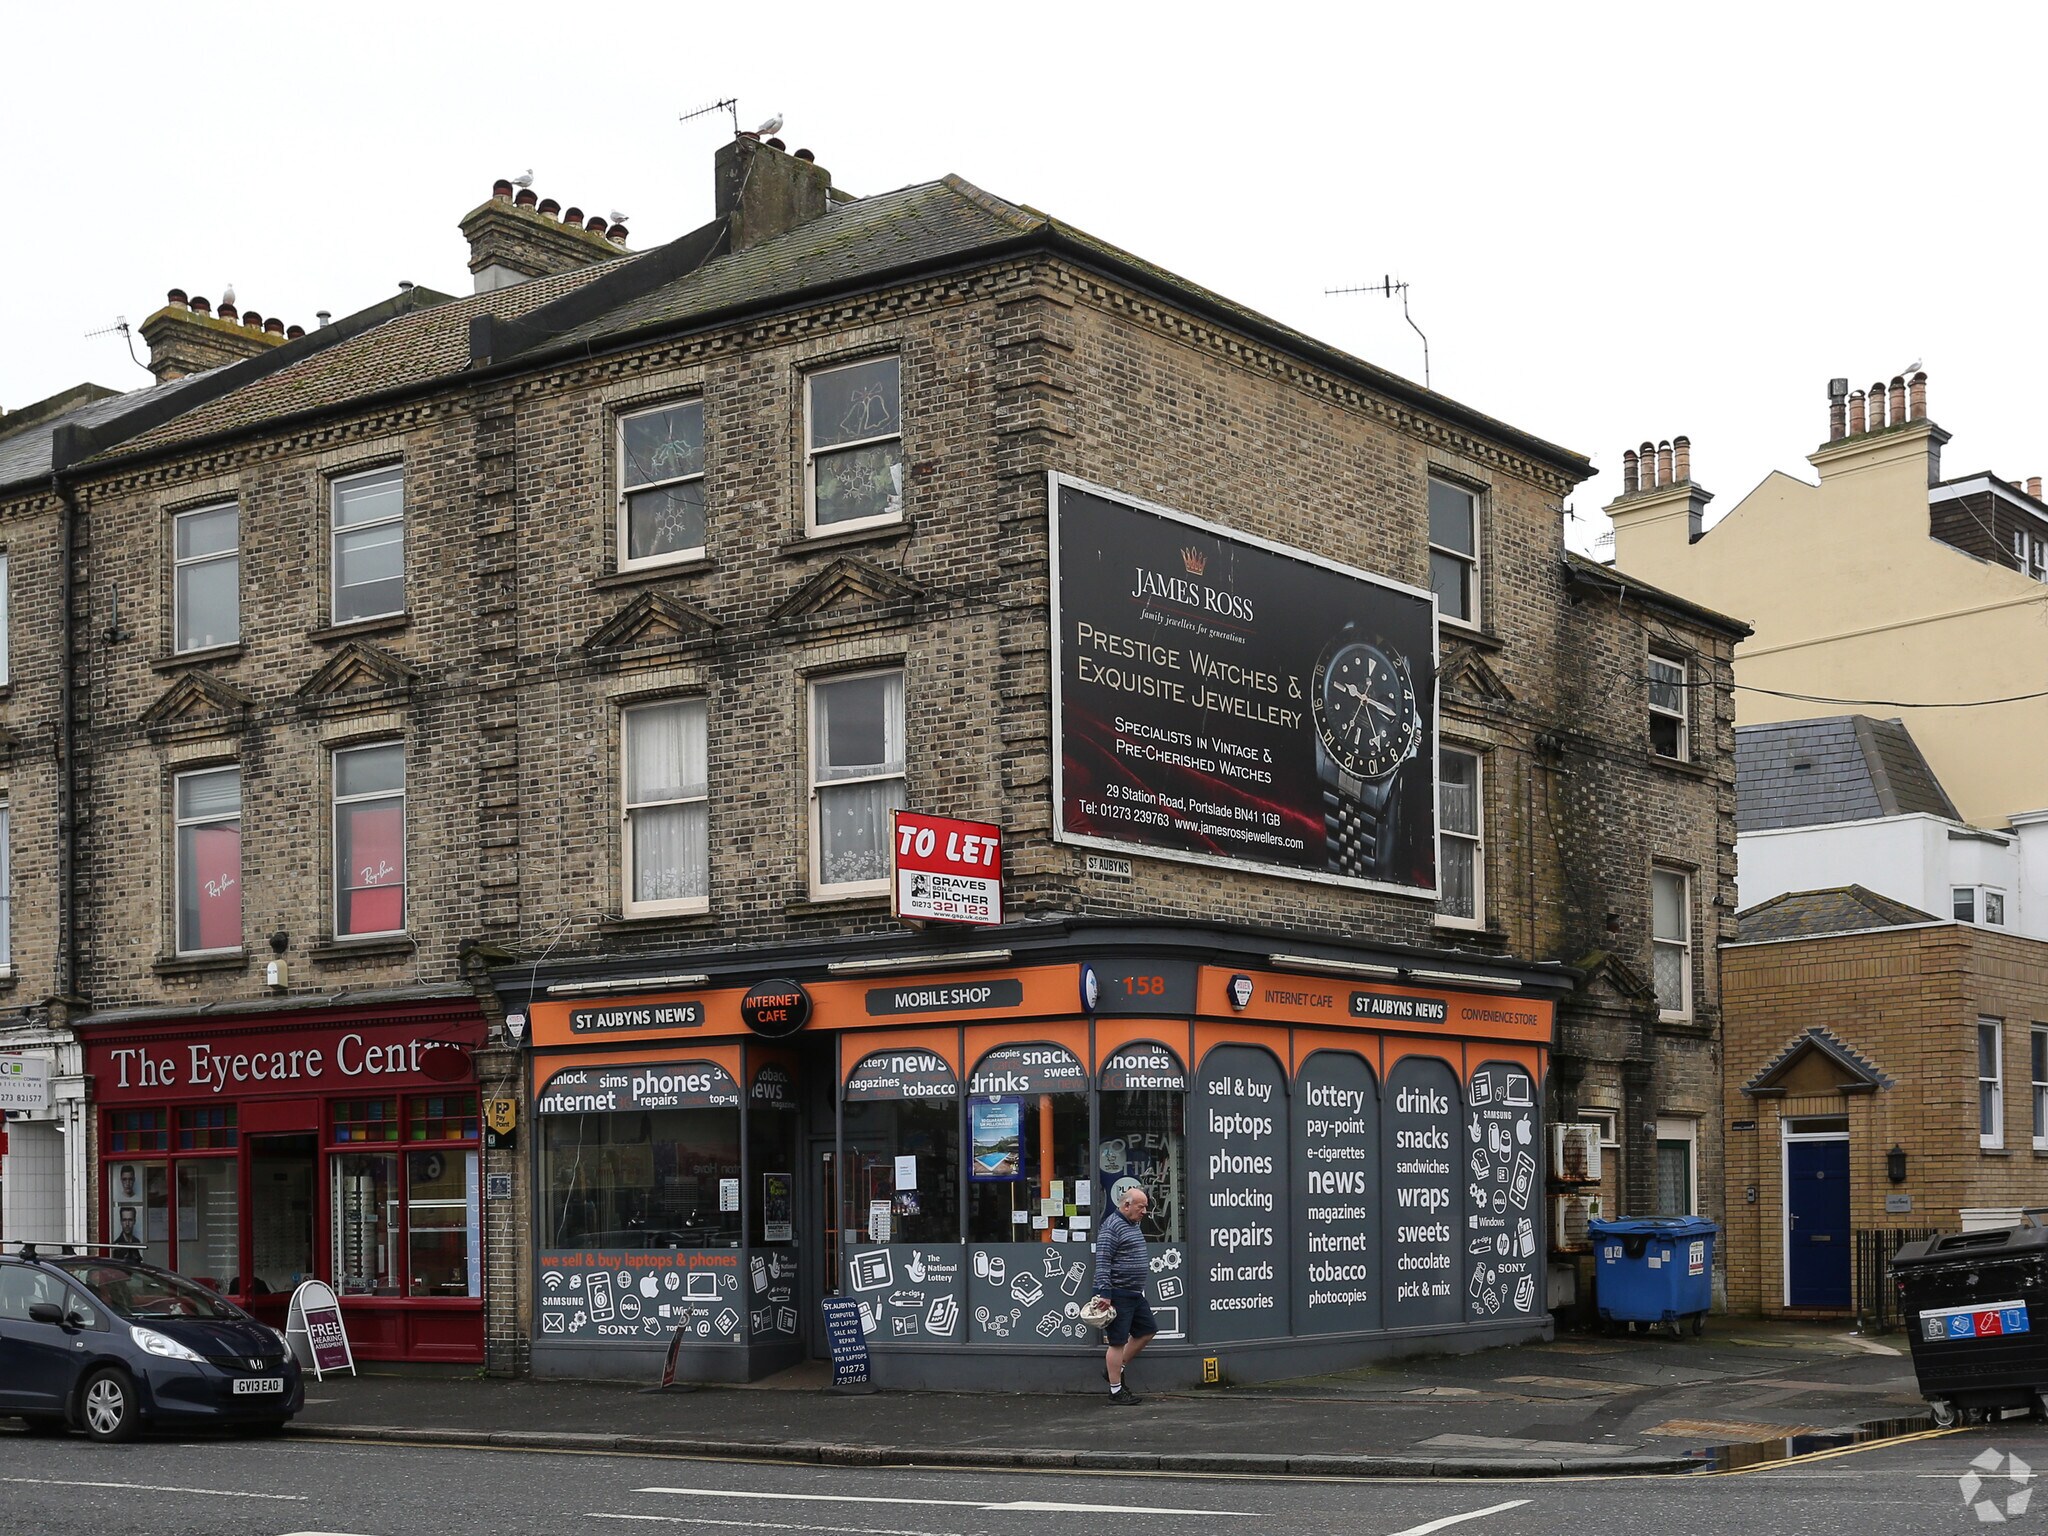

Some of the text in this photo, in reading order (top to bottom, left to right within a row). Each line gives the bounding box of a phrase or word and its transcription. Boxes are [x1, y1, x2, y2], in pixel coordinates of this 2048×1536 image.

[1132, 567, 1254, 622] JAMES ROSS
[1140, 608, 1246, 644] family jewellers for generations
[1078, 621, 1302, 700] PRESTIGE WATCHES &
[1078, 656, 1302, 729] EXQUISITE JEWELLERY
[1114, 716, 1273, 764] SPECIALISTS IN VINTAGE &
[1115, 739, 1272, 784] PRE-CHERISHED WATCHES
[1106, 784, 1281, 827] 29 Station Road, Portslade BN41 1GB
[1078, 799, 1304, 850] Tel: 01273 239763 www.jamesrossjewellers.com
[898, 825, 999, 867] TO LET
[1099, 858, 1129, 874] AUBYNS
[932, 876, 987, 891] GRAVES
[932, 891, 989, 905] PILCHER
[911, 900, 989, 916] 01273 321 123
[1122, 976, 1165, 995] 158
[746, 994, 800, 1008] INTERNET
[894, 987, 991, 1008] MOBILE SHOP
[1265, 990, 1309, 1007] INTERNET
[1310, 993, 1333, 1008] CAFE
[757, 1010, 787, 1023] CAFE
[1356, 997, 1444, 1019] ST AUBYNS NEWS
[1461, 1008, 1537, 1025] CONVENIENCE STORE
[576, 1007, 695, 1029] ST AUBYNS NEWS
[110, 1033, 461, 1093] The Eyecare Cent
[1022, 1049, 1076, 1065] snack
[1106, 1055, 1169, 1070] hones
[1044, 1065, 1083, 1078] sweet
[1125, 1073, 1185, 1088] internet
[599, 1074, 628, 1091] sims
[632, 1070, 711, 1101] phones
[902, 1082, 956, 1096] tobacco
[969, 1070, 1030, 1093] drinks
[1209, 1076, 1272, 1103] sell & buy
[17, 1094, 42, 1102] 821577
[640, 1093, 678, 1108] repairs
[1306, 1081, 1364, 1115] lottery
[1396, 1087, 1448, 1115] drinks
[496, 1115, 506, 1123] Pay
[496, 1120, 510, 1128] Point
[1483, 1110, 1512, 1120] SAMSUNG
[1209, 1108, 1272, 1141] laptops
[1307, 1116, 1365, 1138] pay-point
[1396, 1125, 1449, 1150] snacks
[1210, 1148, 1273, 1180] phones
[1307, 1145, 1365, 1165] e-cigarettes
[1397, 1159, 1450, 1176] sandwiches
[1308, 1169, 1365, 1194] news
[1209, 1187, 1273, 1212] unlocking
[1397, 1184, 1450, 1214] wraps
[1308, 1205, 1366, 1225] magazines
[1479, 1217, 1506, 1228] Windows
[1210, 1221, 1273, 1253] repairs
[1397, 1221, 1450, 1243] sweets
[1308, 1232, 1366, 1253] internet
[541, 1252, 737, 1271] we sell & buy laptops & phones
[927, 1254, 940, 1262] The
[1398, 1252, 1450, 1271] chocolate
[927, 1264, 957, 1272] National
[1210, 1261, 1274, 1282] sim cards
[1309, 1261, 1366, 1283] tobacco
[1498, 1263, 1527, 1273] SONY
[927, 1274, 952, 1283] Lottery
[902, 1289, 920, 1298] e-cigs
[1309, 1288, 1367, 1307] photocopies
[1398, 1280, 1450, 1302] pick & mix
[542, 1297, 584, 1306] SAMSUNG
[622, 1303, 639, 1311] DELL
[1210, 1293, 1274, 1311] accessories
[310, 1322, 341, 1337] FREE
[598, 1326, 639, 1335] SONY
[313, 1335, 342, 1344] HEARING
[315, 1341, 343, 1350] ASSESSMENT
[853, 1344, 866, 1352] CASH
[846, 1353, 867, 1361] LAPTOPS
[840, 1364, 865, 1374] 01273
[240, 1380, 260, 1392] GV13
[836, 1374, 867, 1385] 733146
